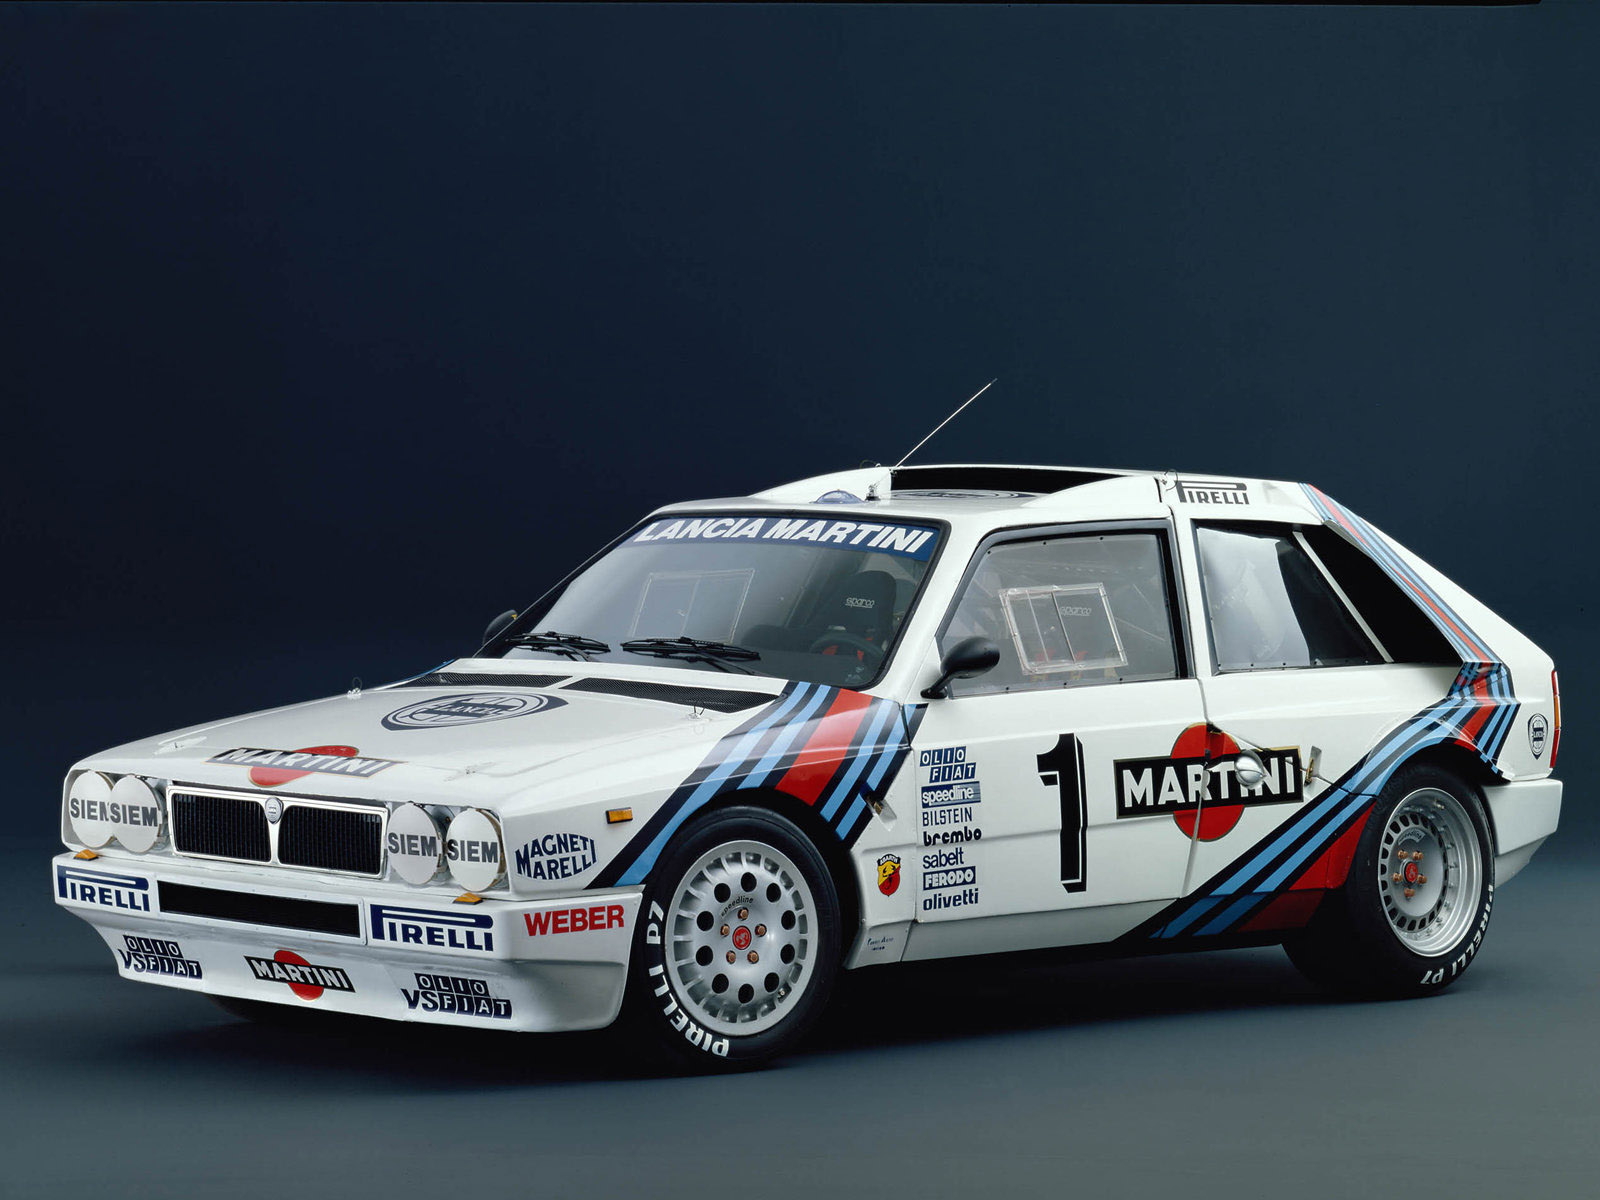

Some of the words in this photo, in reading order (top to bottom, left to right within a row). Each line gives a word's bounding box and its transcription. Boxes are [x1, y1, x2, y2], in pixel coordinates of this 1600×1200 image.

[1174, 480, 1249, 504] PIRELLI
[633, 518, 766, 542] LANCIA
[763, 518, 934, 553] MARTINI
[216, 748, 392, 775] MARTINI
[920, 748, 966, 766] OLIO
[930, 763, 976, 782] FIAT
[1122, 756, 1296, 808] MARTNI
[922, 785, 975, 806] speedline
[110, 803, 158, 827] SIEM
[922, 807, 973, 827] BILSTEIN
[1036, 733, 1088, 893] 1
[388, 832, 437, 857] SIEM
[515, 833, 596, 863] MAGNETI
[923, 826, 982, 847] brembo
[447, 839, 498, 863] SIEM
[923, 847, 964, 869] sabelt
[515, 850, 596, 880] MARELLI
[57, 864, 150, 912] PIRELLI
[924, 868, 975, 889] FERODO
[923, 888, 979, 911] olivetti
[370, 904, 493, 951] PIRELLI
[524, 905, 625, 937] WEBER
[647, 900, 665, 945] P7
[1452, 884, 1494, 976] PIRELLI
[124, 936, 182, 958] OLIO
[250, 958, 350, 989] MARTINI
[415, 973, 488, 996] OLIO
[1420, 968, 1444, 985] P7
[649, 964, 730, 1057] PIRELLI
